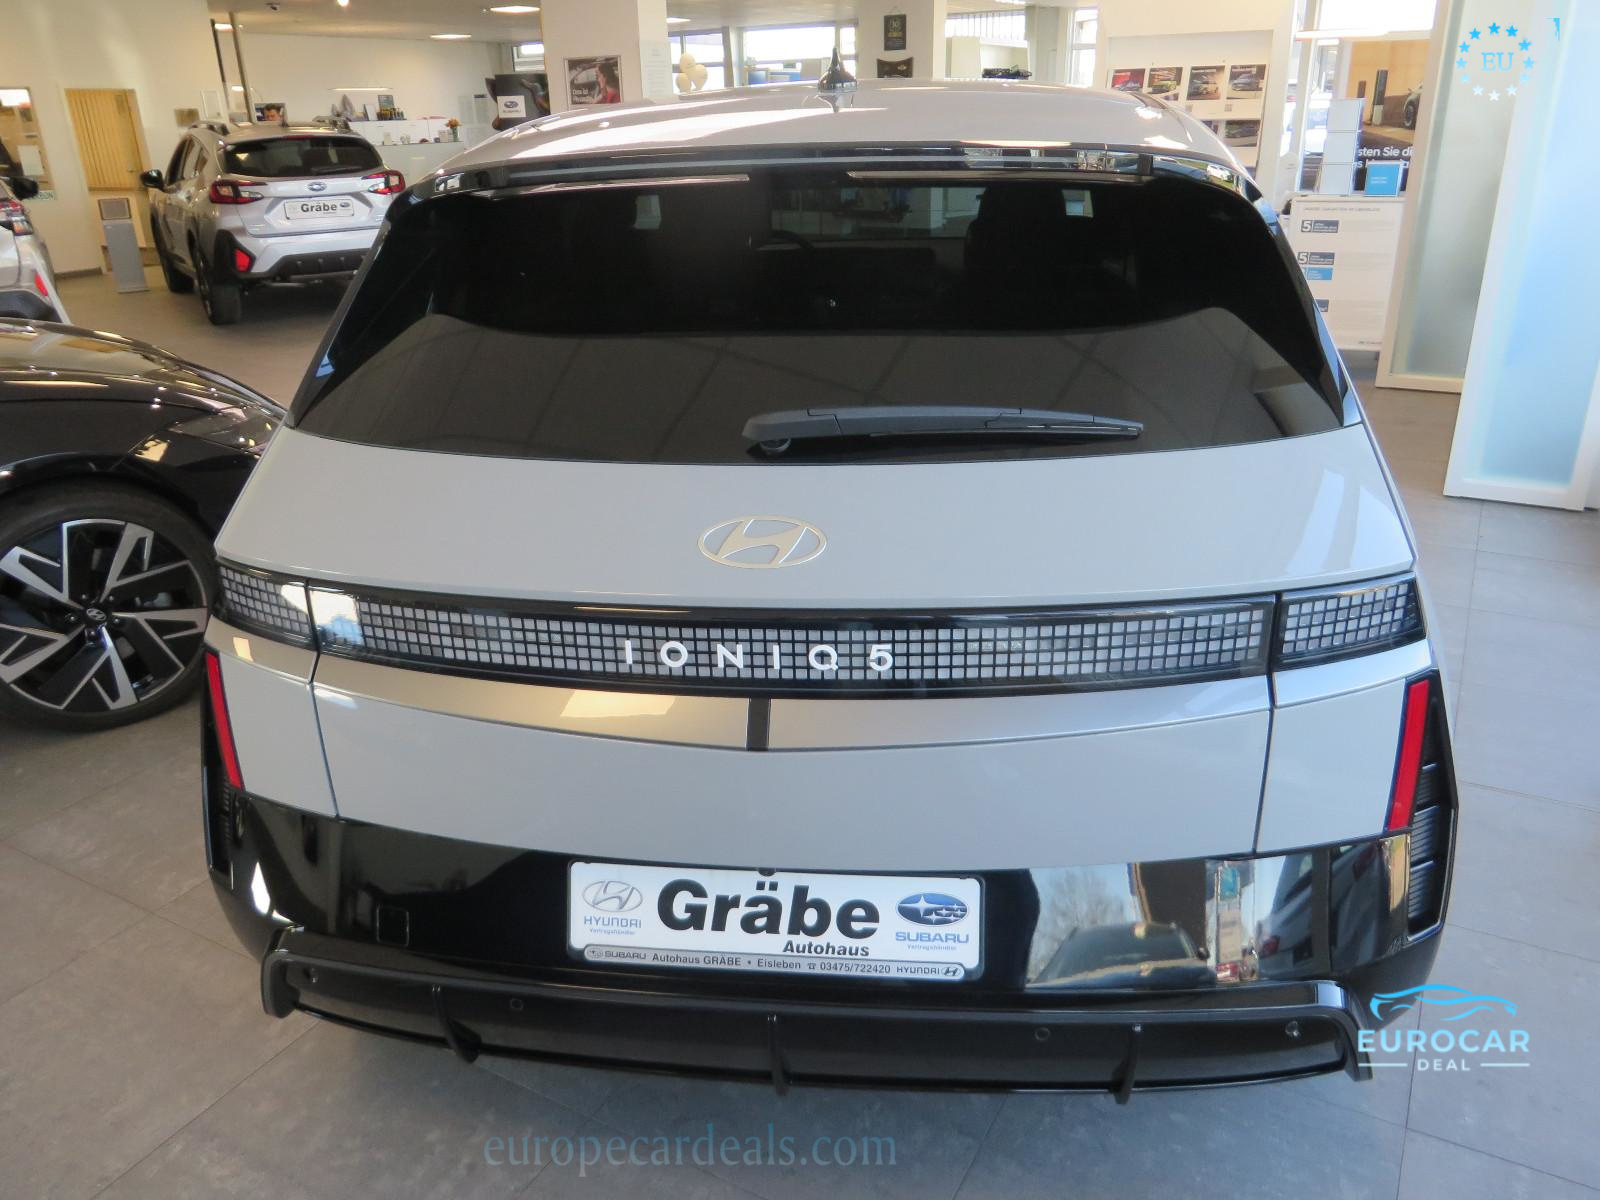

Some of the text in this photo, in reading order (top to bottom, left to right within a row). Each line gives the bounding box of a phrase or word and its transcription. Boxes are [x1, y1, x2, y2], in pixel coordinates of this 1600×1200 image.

[1382, 145, 1400, 157] Sie
[300, 202, 337, 213] Gräbe
[1302, 220, 1312, 232] 5
[657, 878, 880, 939] Gräbe
[583, 915, 642, 929] HYUNDAI
[895, 931, 970, 944] SUBARU
[783, 939, 870, 957] Autohaus
[604, 950, 940, 975] SUBARU Autohaus GRÄBE Eisleben 03475/722420 HYUNDAI
